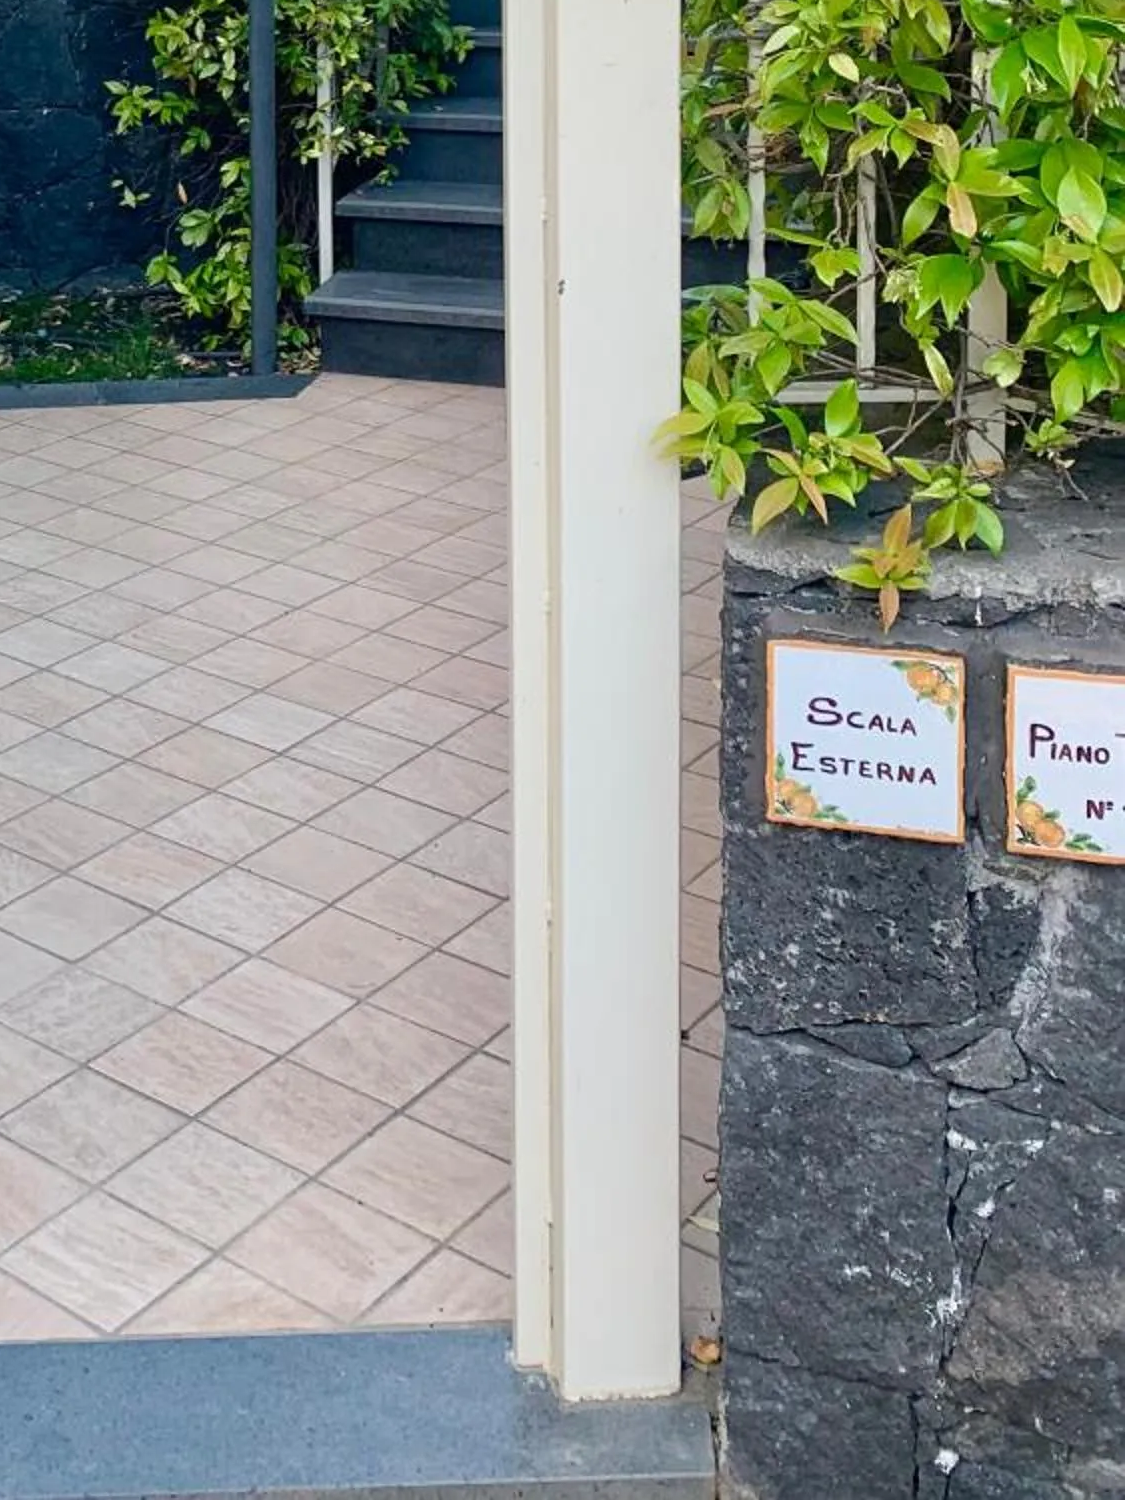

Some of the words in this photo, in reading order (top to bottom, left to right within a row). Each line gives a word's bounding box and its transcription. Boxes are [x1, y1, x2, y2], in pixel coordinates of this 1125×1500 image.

[807, 697, 917, 736] SCALA
[790, 741, 937, 785] ESTERNA
[1029, 723, 1110, 764] PIANO
